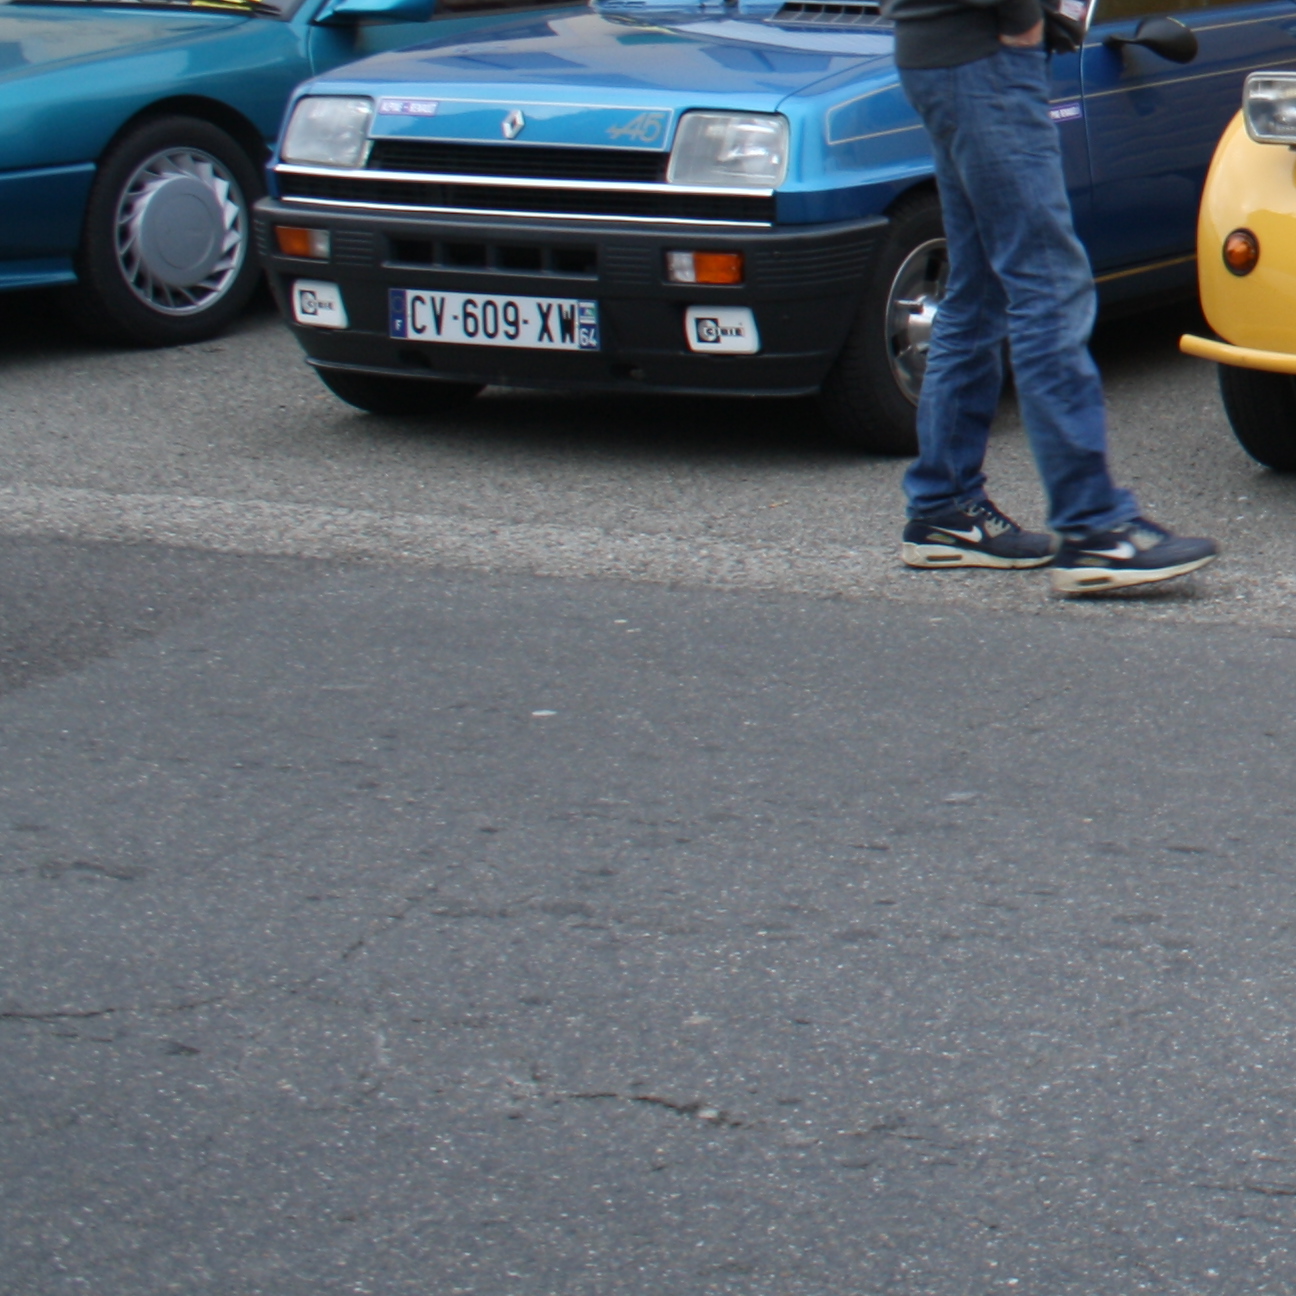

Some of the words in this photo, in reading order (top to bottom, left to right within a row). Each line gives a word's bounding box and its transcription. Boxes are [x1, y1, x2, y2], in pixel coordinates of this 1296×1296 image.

[395, 319, 402, 330] F
[410, 295, 576, 344] CV-609-XW
[580, 328, 597, 347] 64
